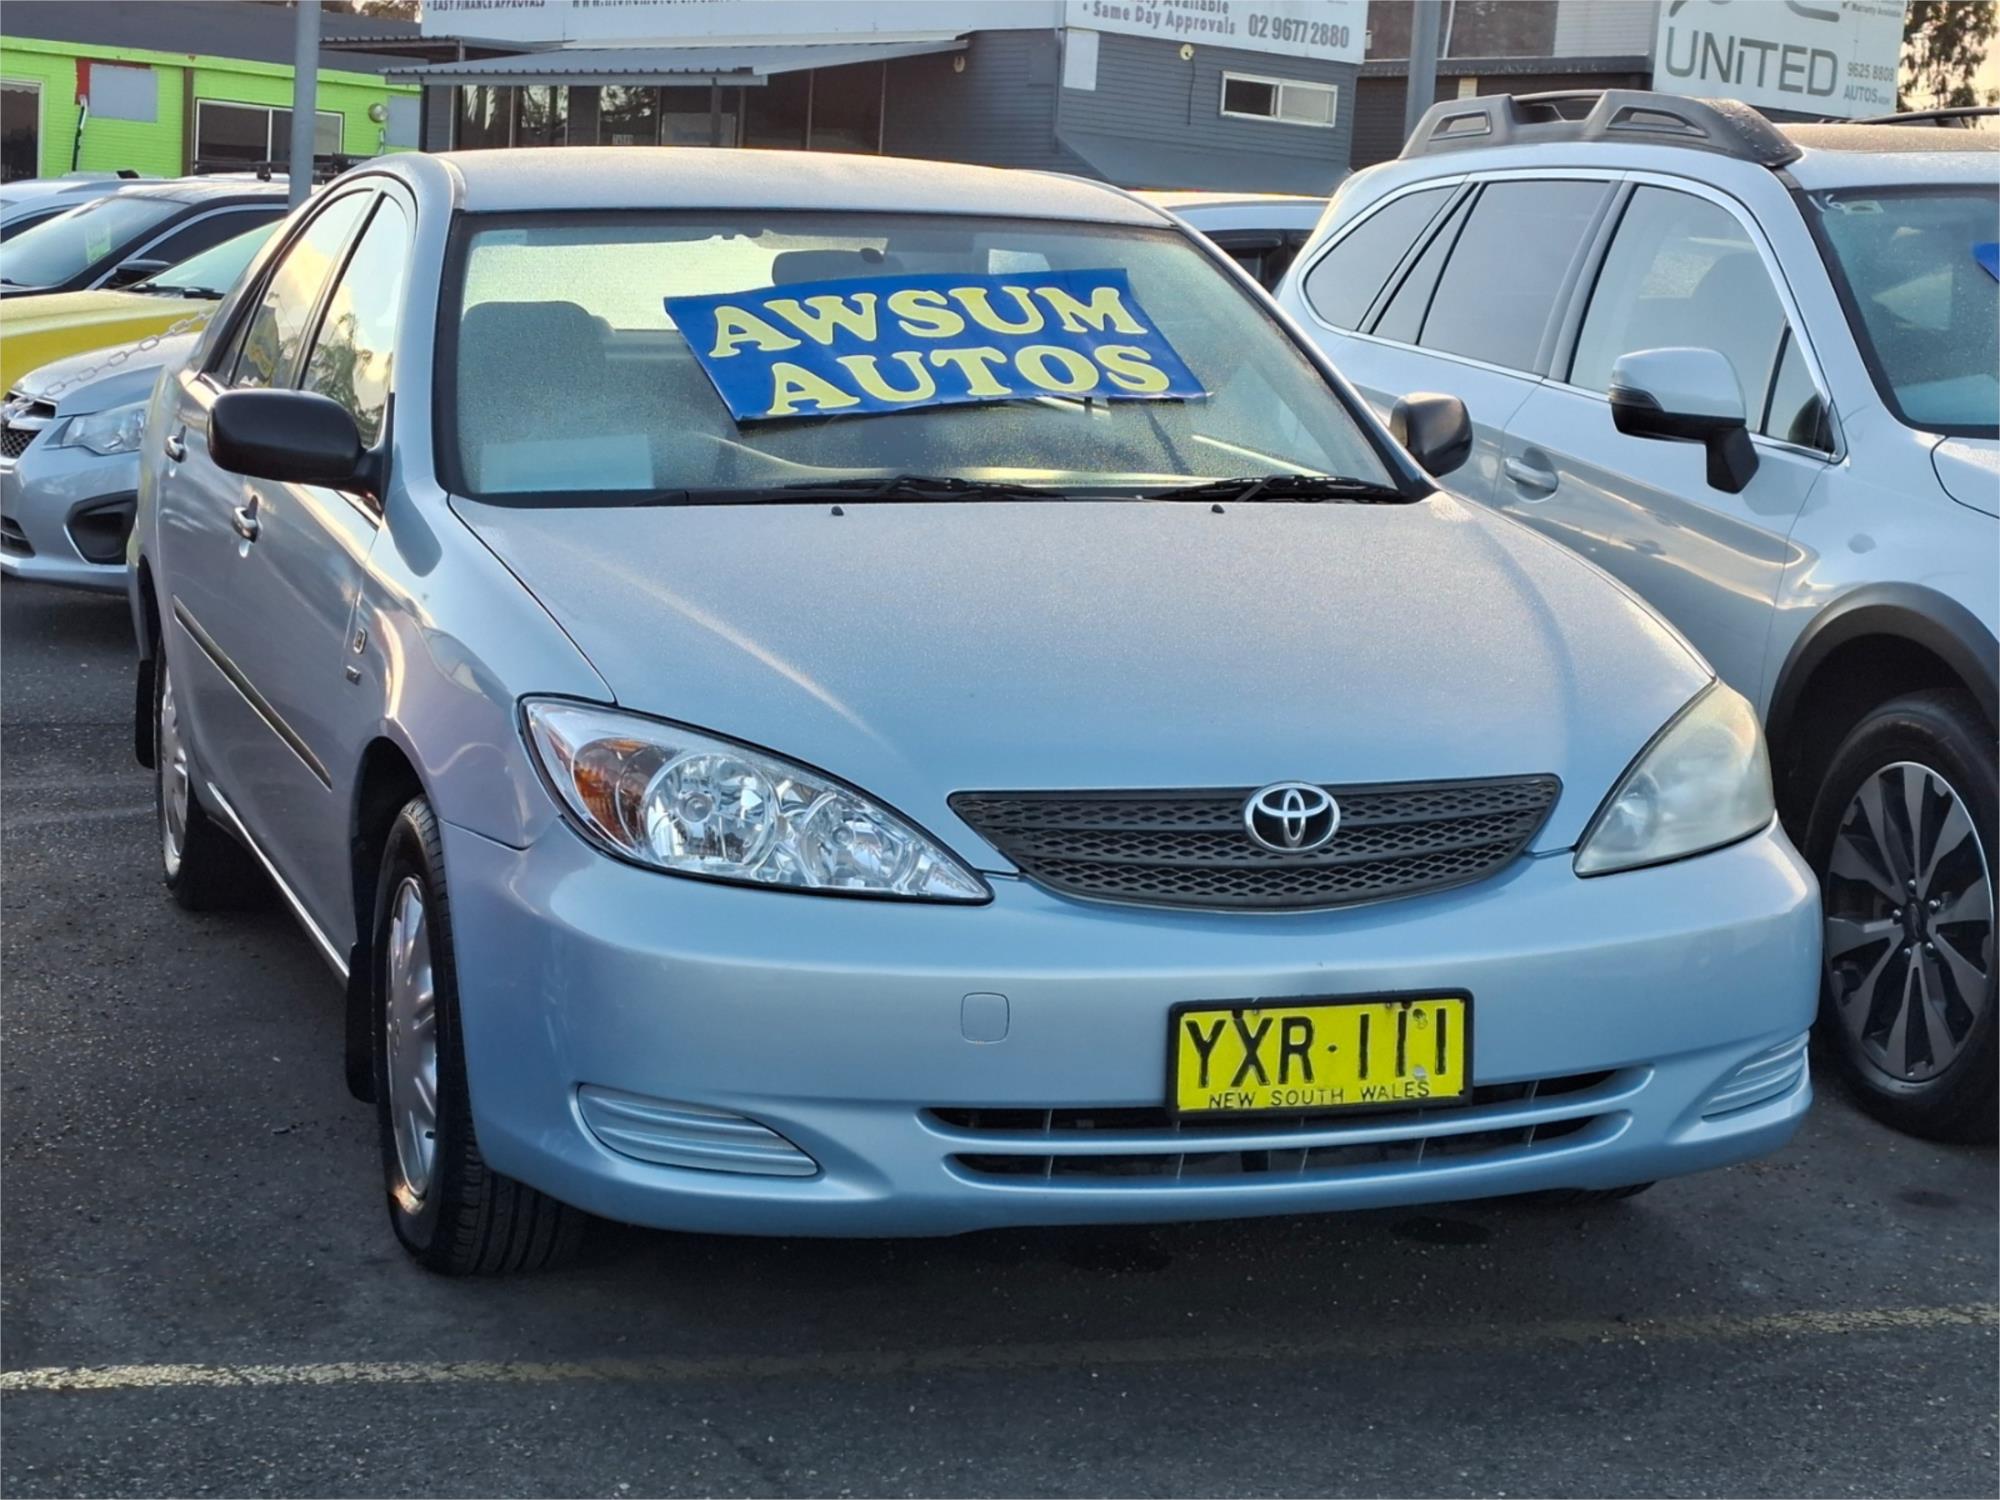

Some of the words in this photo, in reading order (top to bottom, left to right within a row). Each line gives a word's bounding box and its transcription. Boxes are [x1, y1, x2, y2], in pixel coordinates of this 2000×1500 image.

[1093, 1, 1131, 21] Same
[1135, 6, 1162, 29] Day
[1165, 10, 1236, 35] Approvals
[1248, 13, 1269, 38] 02
[1271, 16, 1309, 44] 9677
[1310, 21, 1350, 49] 2880
[1843, 84, 1879, 103] AUTOS
[709, 286, 1149, 359] AWSUM
[767, 345, 1171, 416] AUTOS
[1208, 1091, 1256, 1110] NEW
[1270, 1087, 1345, 1106] SOUTH
[1360, 1081, 1431, 1101] WALES
